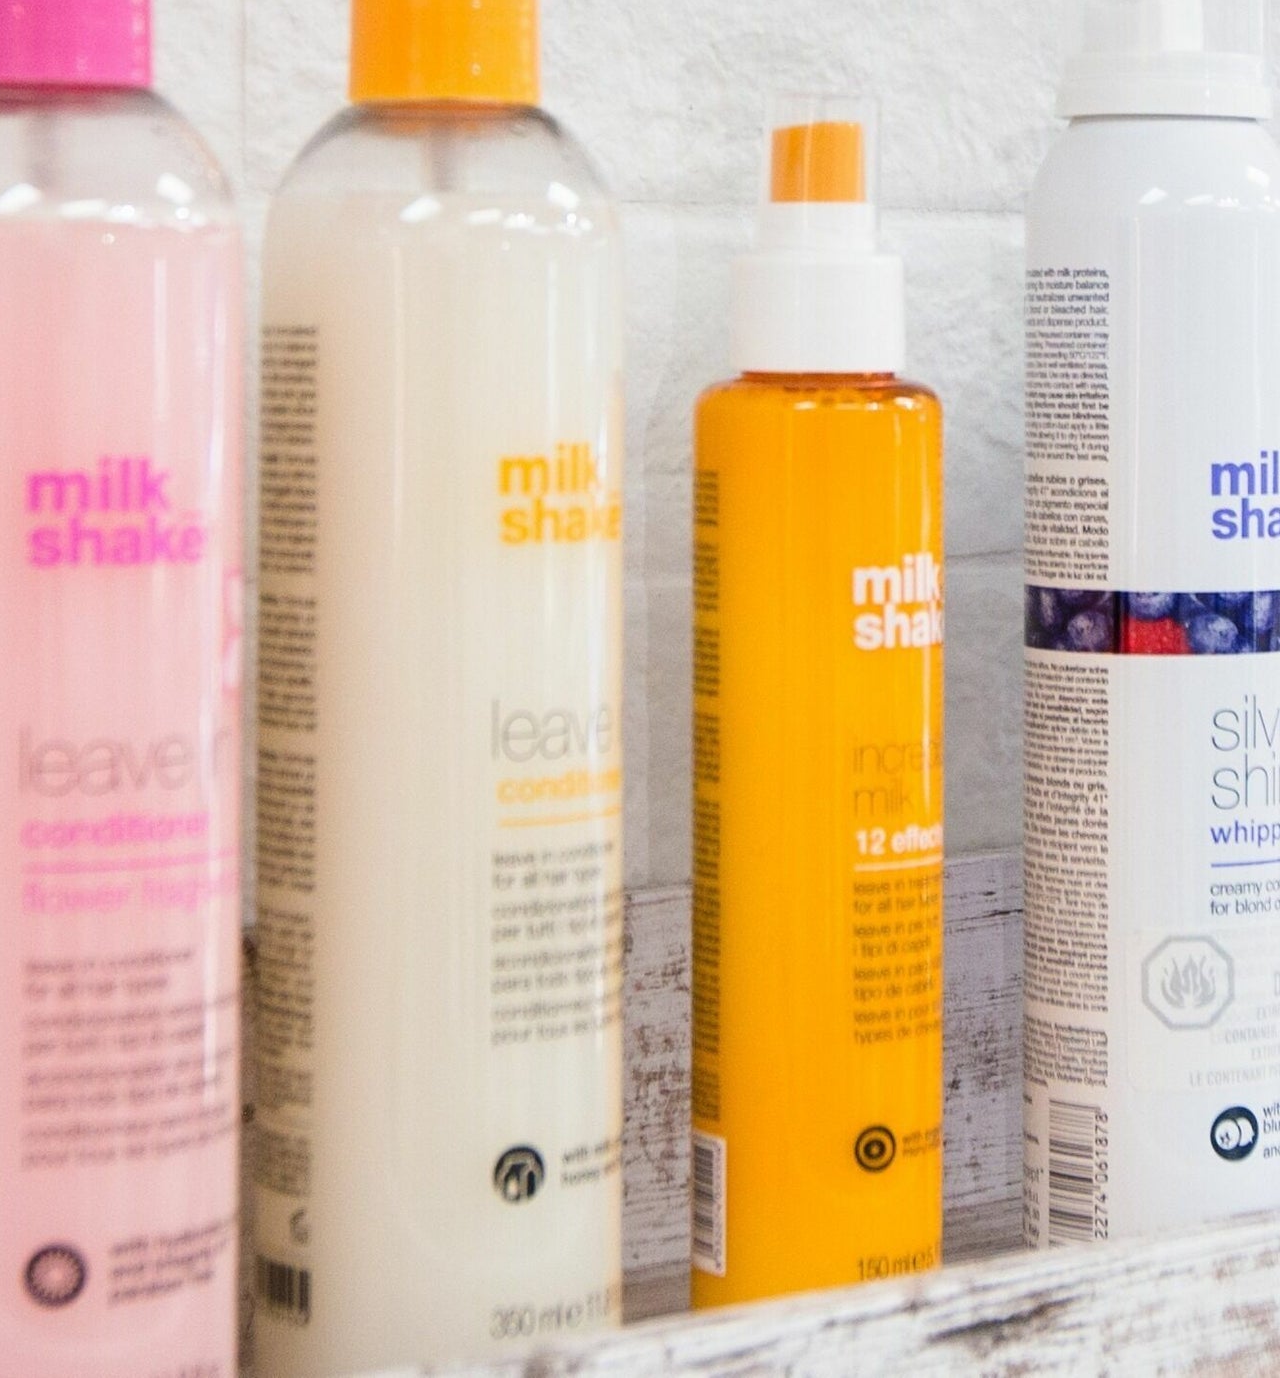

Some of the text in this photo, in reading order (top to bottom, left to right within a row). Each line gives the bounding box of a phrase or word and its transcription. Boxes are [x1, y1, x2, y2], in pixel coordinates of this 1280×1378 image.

[1075, 281, 1109, 290] balance
[25, 454, 170, 513] milk
[29, 510, 208, 568] shake
[1082, 525, 1109, 535] Modo
[851, 551, 940, 607] milk
[855, 827, 887, 856] 12
[1210, 881, 1262, 899] creamy
[1210, 899, 1230, 918] for
[1235, 894, 1271, 915] blond
